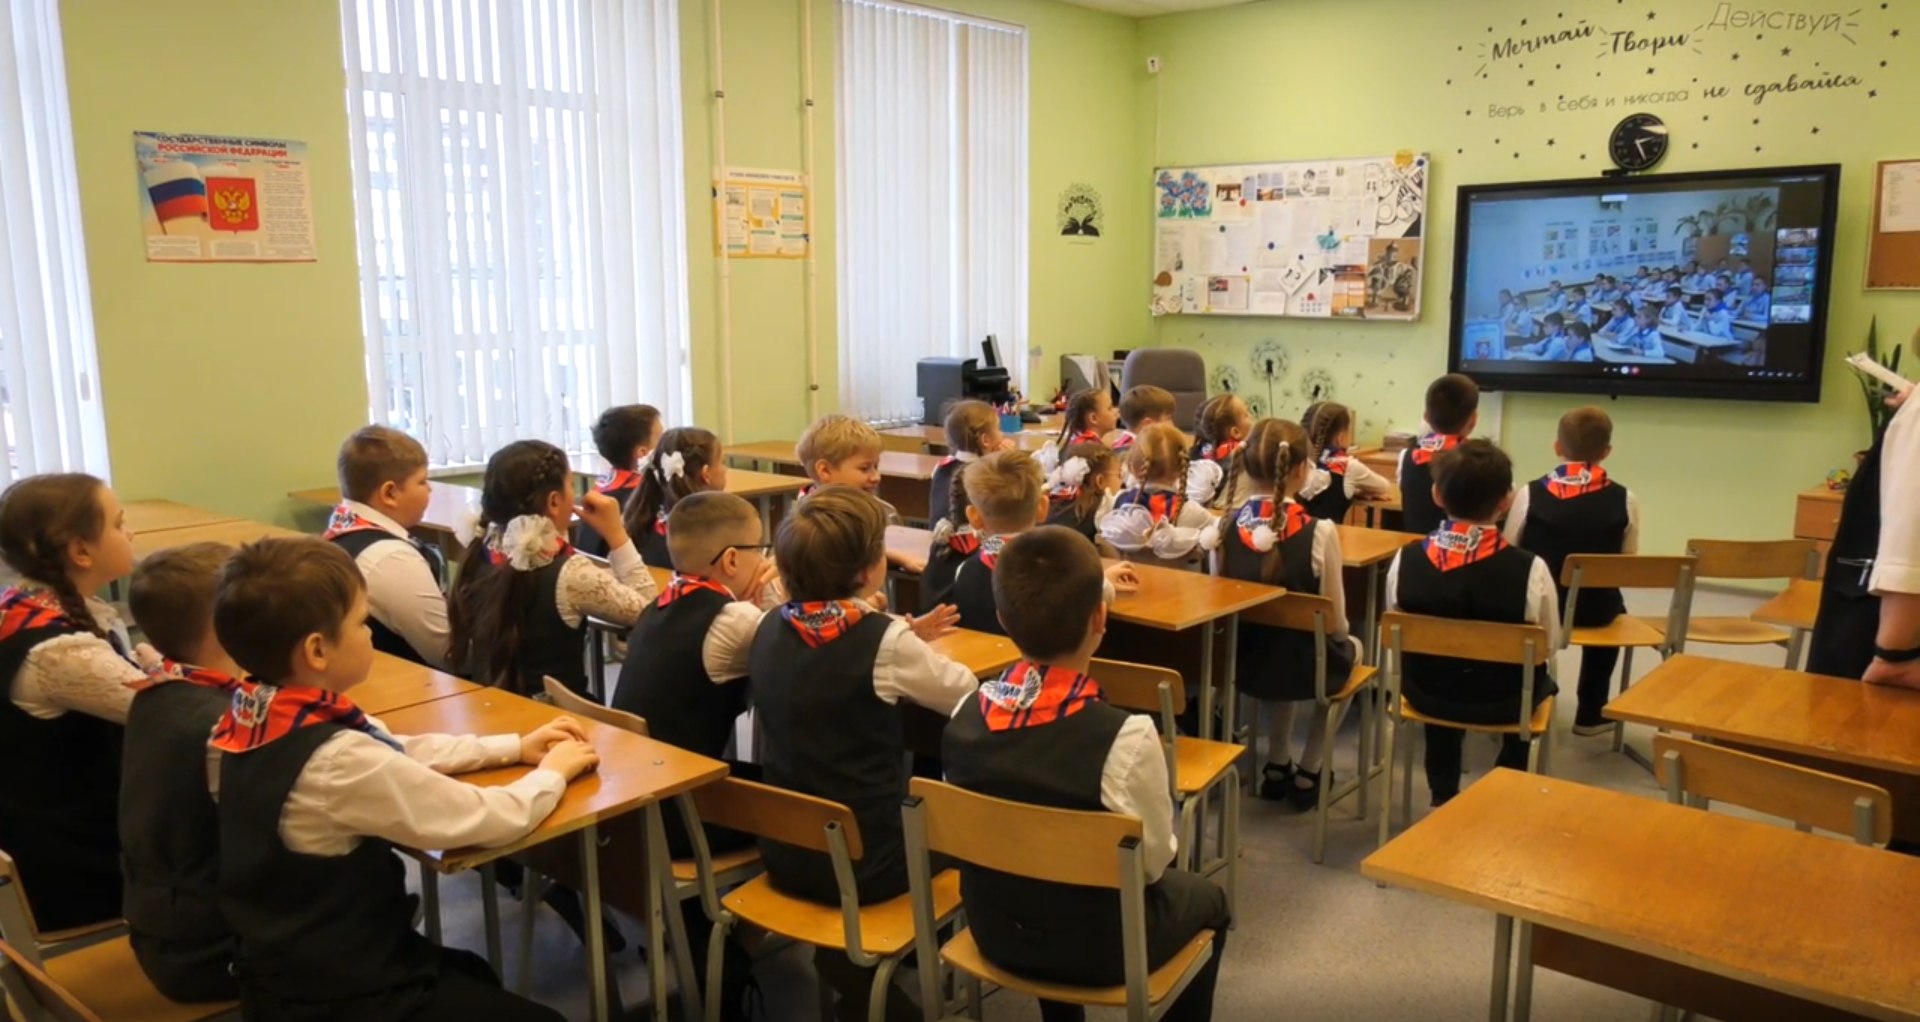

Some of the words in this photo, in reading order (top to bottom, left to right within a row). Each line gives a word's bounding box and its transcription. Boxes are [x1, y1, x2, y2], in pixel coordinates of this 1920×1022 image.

[1492, 19, 1596, 61] Мечтай
[1609, 30, 1690, 56] Твори
[1707, 2, 1842, 36] Действуй
[1488, 103, 1525, 119] Верь
[1540, 102, 1547, 113] в
[1557, 96, 1598, 112] себя
[1605, 97, 1615, 107] и
[1624, 89, 1689, 105] никогда
[1703, 85, 1730, 98] не
[1744, 72, 1862, 105] сдавайся
[157, 136, 243, 147] ГОСУДАРСТВЕННЫЕ
[157, 143, 228, 155] РОССИЙСКОЙ
[230, 147, 288, 158] ФЕДЕРАЦИИ
